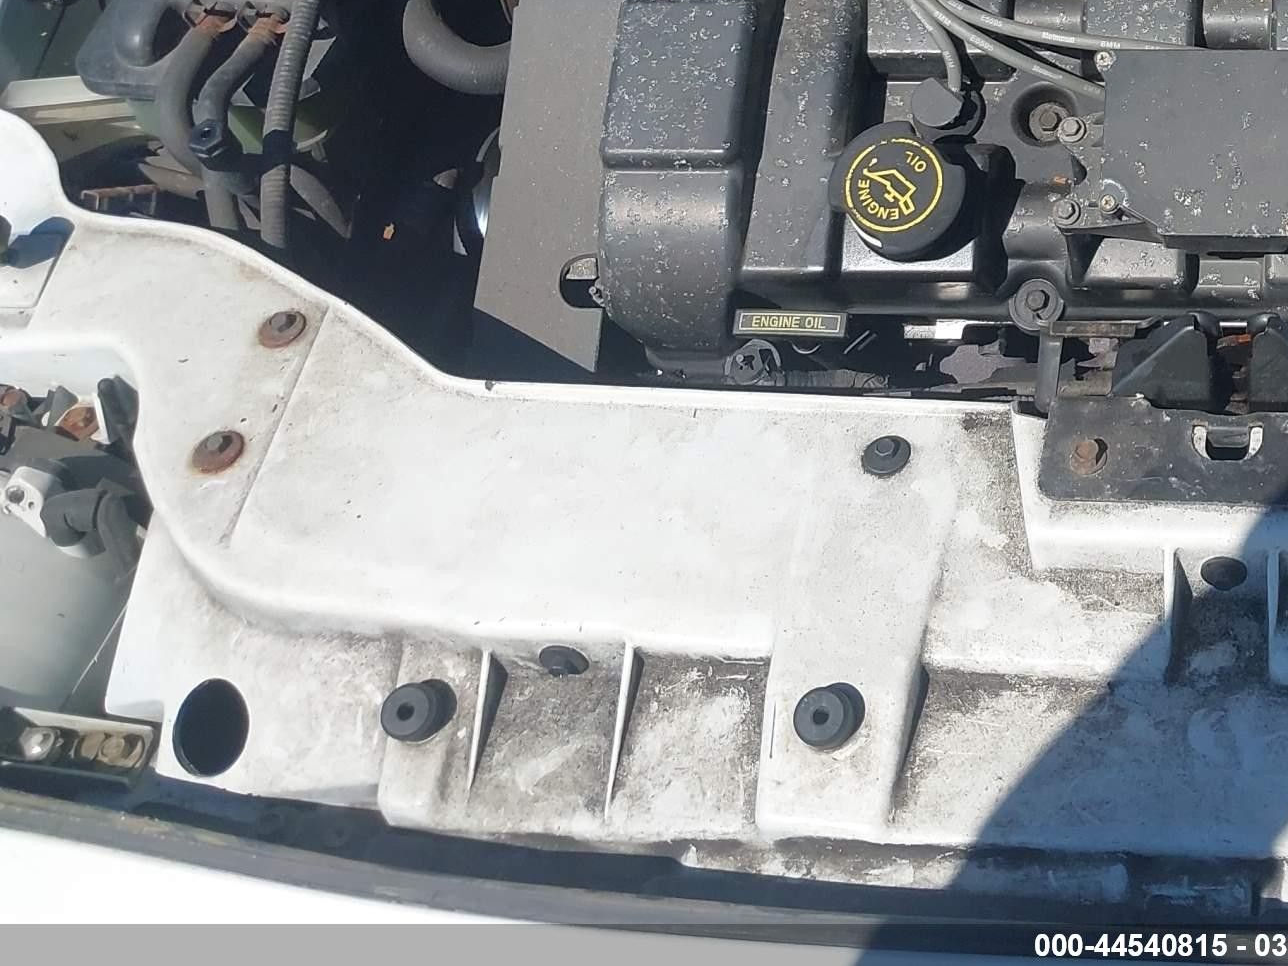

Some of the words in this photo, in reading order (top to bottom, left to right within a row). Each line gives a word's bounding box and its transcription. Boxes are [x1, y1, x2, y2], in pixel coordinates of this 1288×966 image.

[905, 150, 927, 172] OIL
[858, 179, 899, 220] ENGINE
[751, 315, 800, 328] ENGINE
[805, 316, 826, 329] OIL
